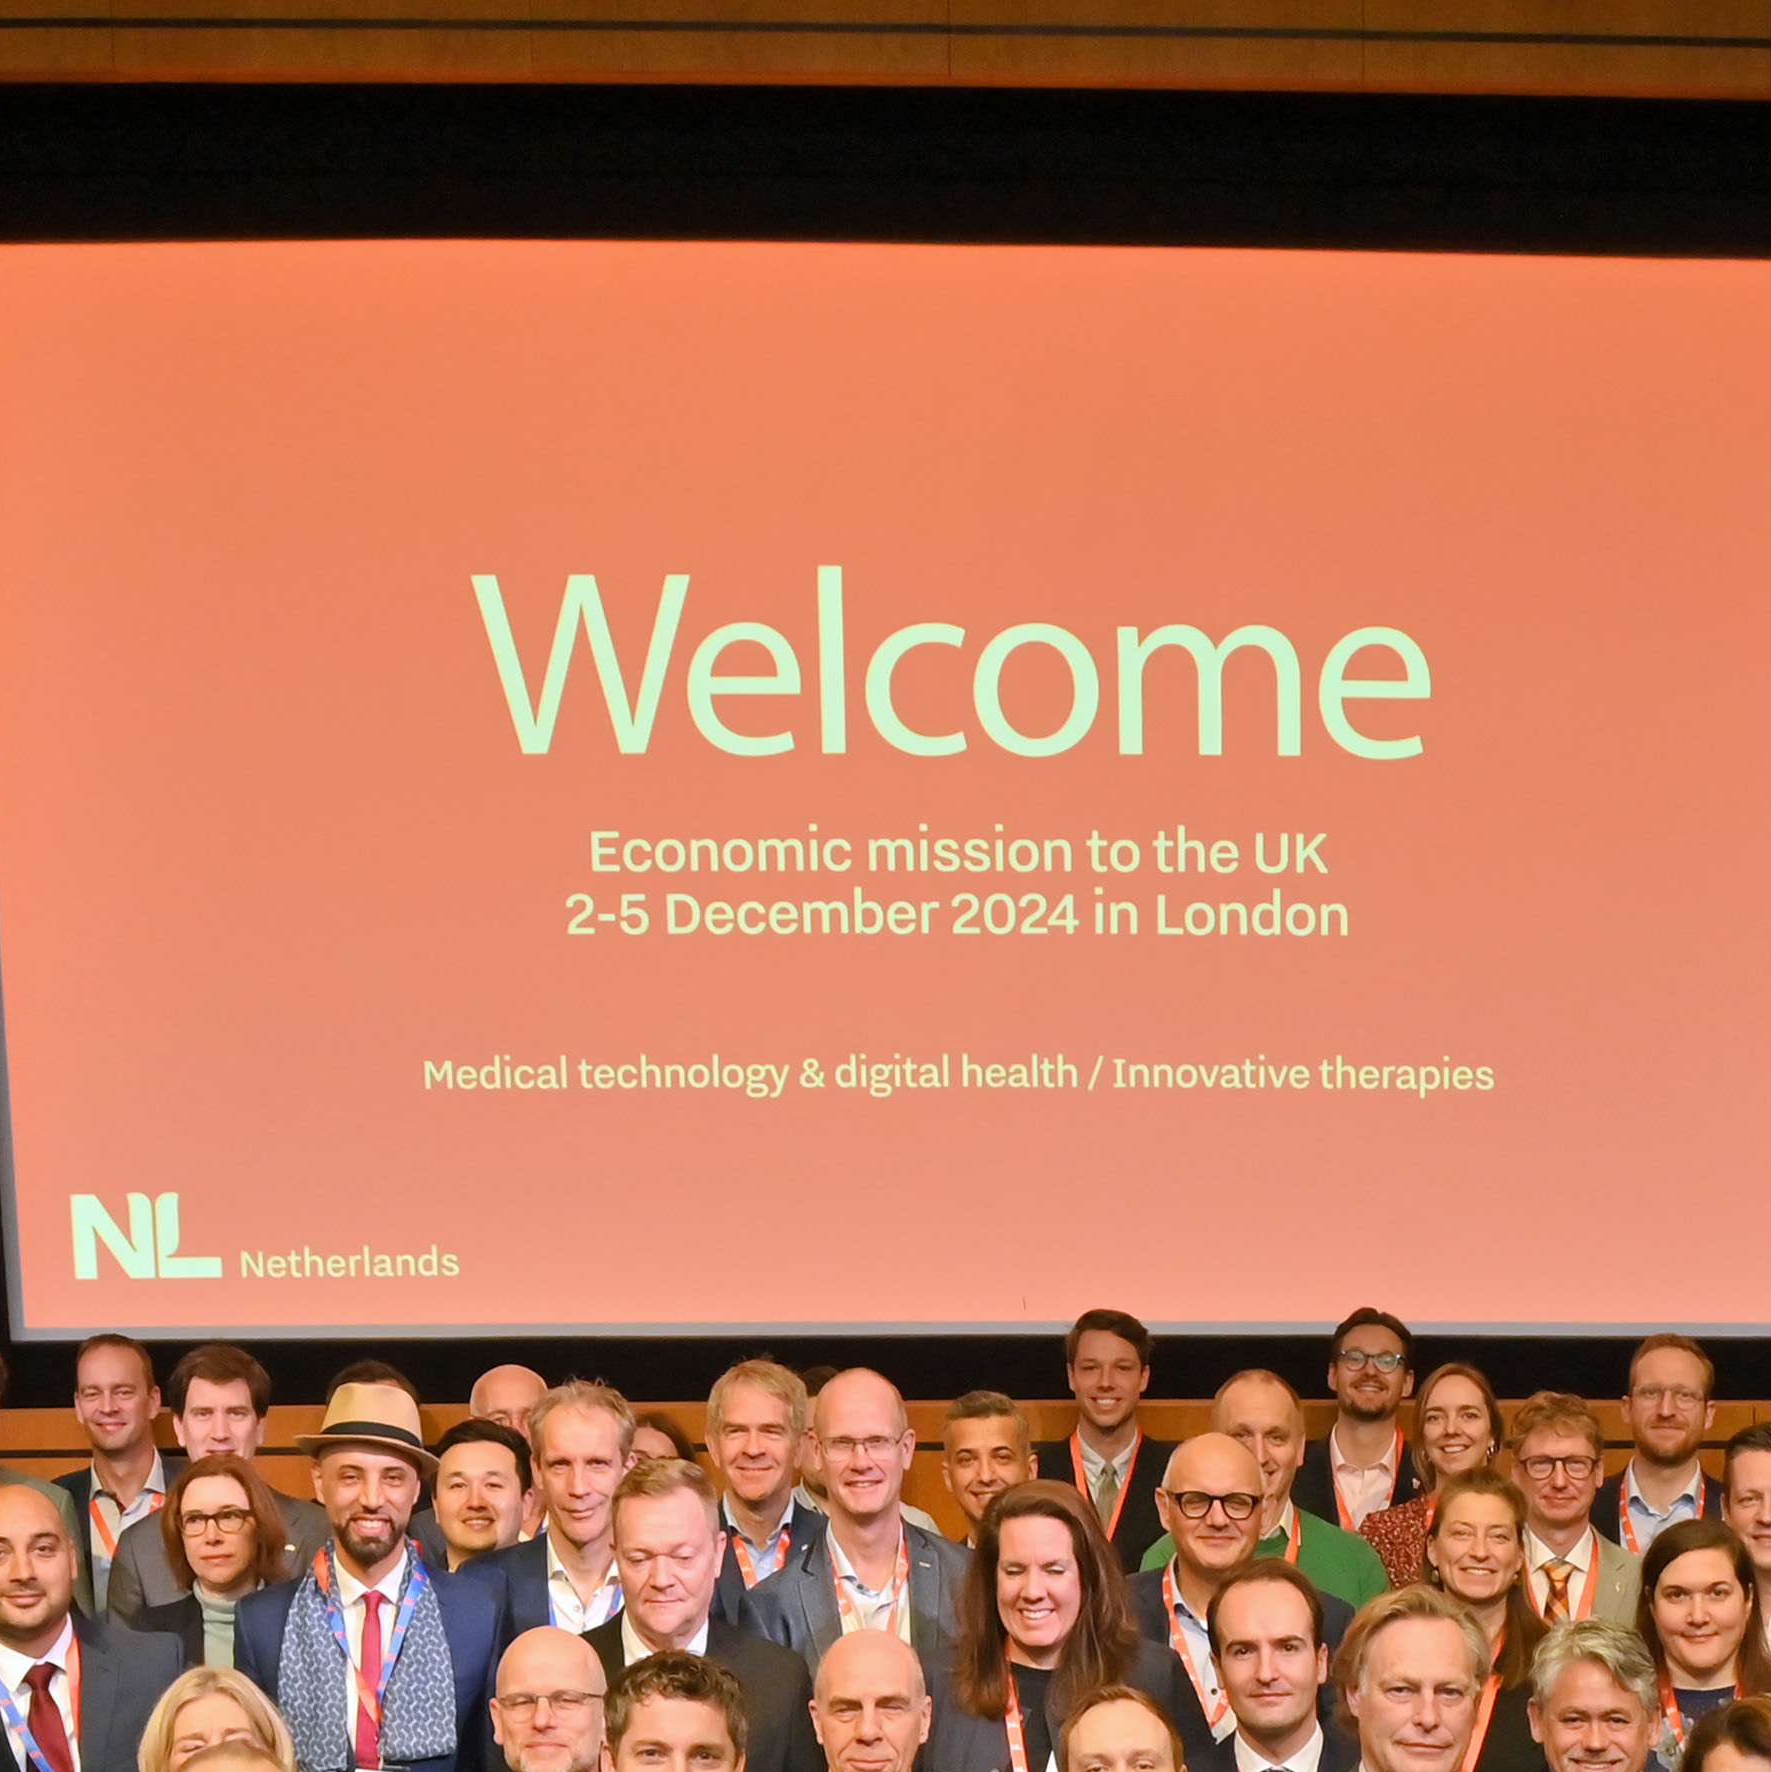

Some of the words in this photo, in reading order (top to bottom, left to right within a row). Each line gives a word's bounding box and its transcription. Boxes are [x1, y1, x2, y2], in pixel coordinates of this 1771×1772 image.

[469, 563, 1433, 762] Welcome
[590, 823, 853, 873] Economic
[868, 823, 1073, 873] mission
[1085, 829, 1141, 873] to
[1152, 824, 1240, 874] the
[1255, 832, 1329, 874] UK
[565, 892, 650, 936] 2-5
[665, 885, 941, 936] December
[950, 892, 1081, 935] 2024
[1094, 886, 1139, 935] in
[1156, 887, 1349, 937] London
[423, 1054, 568, 1090] Medical
[577, 1053, 790, 1099] technology
[799, 1057, 826, 1089] &
[834, 1052, 950, 1098] digital
[961, 1052, 1079, 1089] health
[1087, 1054, 1104, 1091] /
[1112, 1053, 1311, 1090] Innovative
[1318, 1054, 1495, 1099] therapies
[69, 1191, 224, 1281] NL
[240, 1244, 461, 1279] Netherlands
